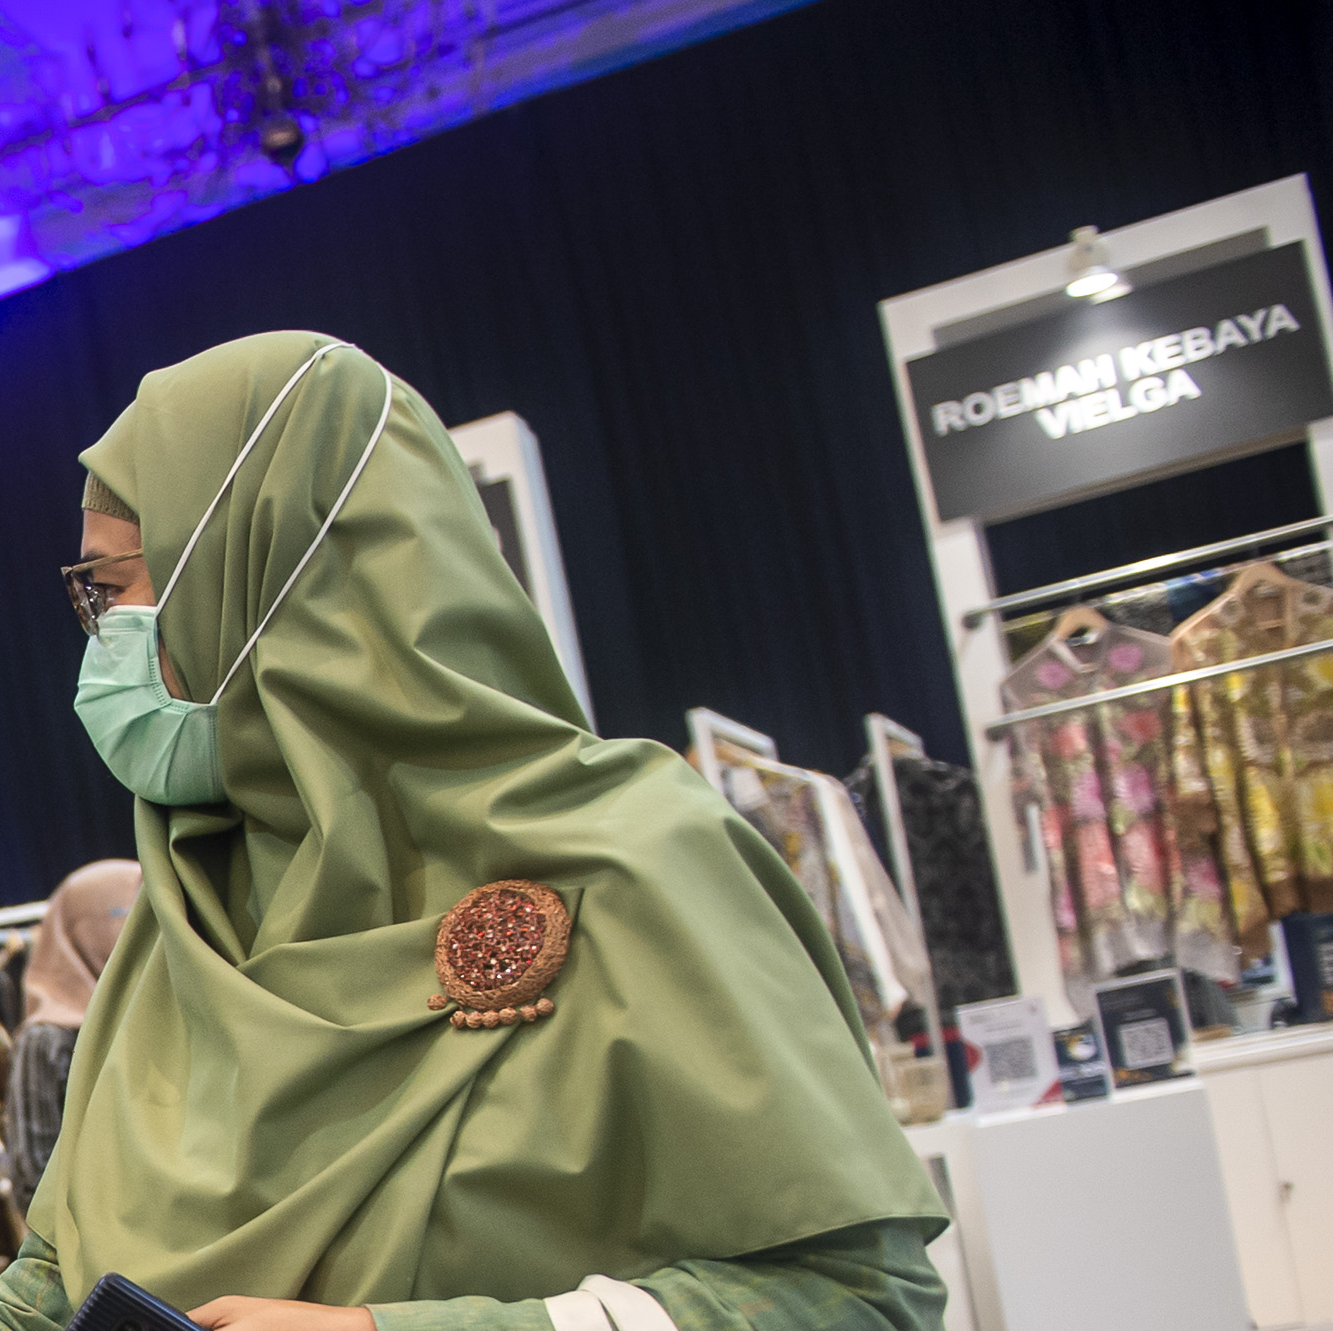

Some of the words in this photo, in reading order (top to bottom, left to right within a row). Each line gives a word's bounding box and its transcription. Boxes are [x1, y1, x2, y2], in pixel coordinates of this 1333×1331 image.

[932, 354, 1117, 437] ROEMAH
[1120, 304, 1301, 381] KEBAYA
[1035, 370, 1202, 439] VIELGA
